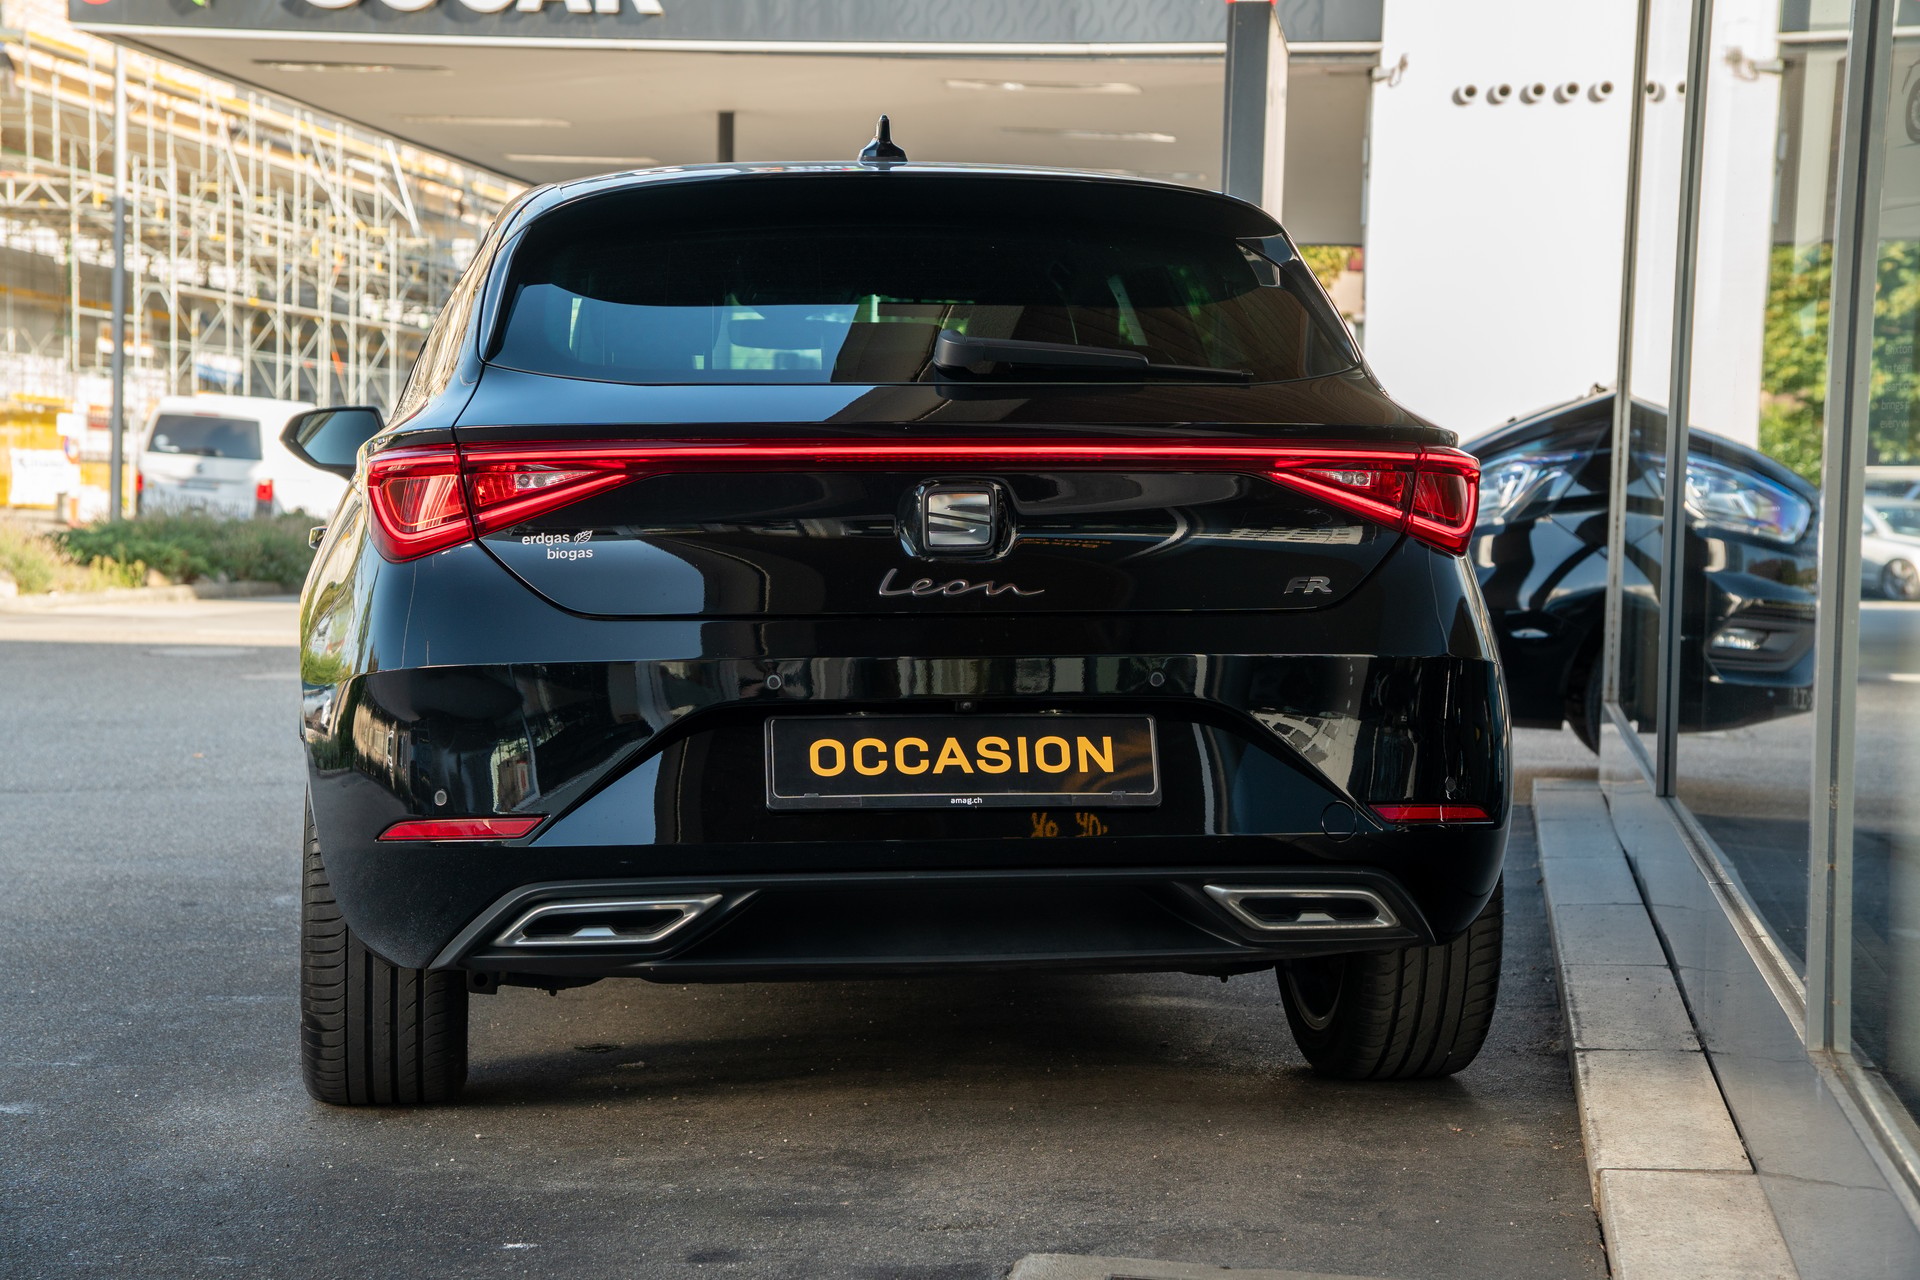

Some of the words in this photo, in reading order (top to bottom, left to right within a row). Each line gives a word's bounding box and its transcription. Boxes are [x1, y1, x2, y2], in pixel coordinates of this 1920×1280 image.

[522, 532, 570, 546] erdgas
[547, 547, 594, 561] biogas
[879, 568, 1045, 596] Leon
[1284, 576, 1332, 594] FR
[809, 736, 1115, 777] OCCASION
[951, 797, 983, 805] amag.ch
